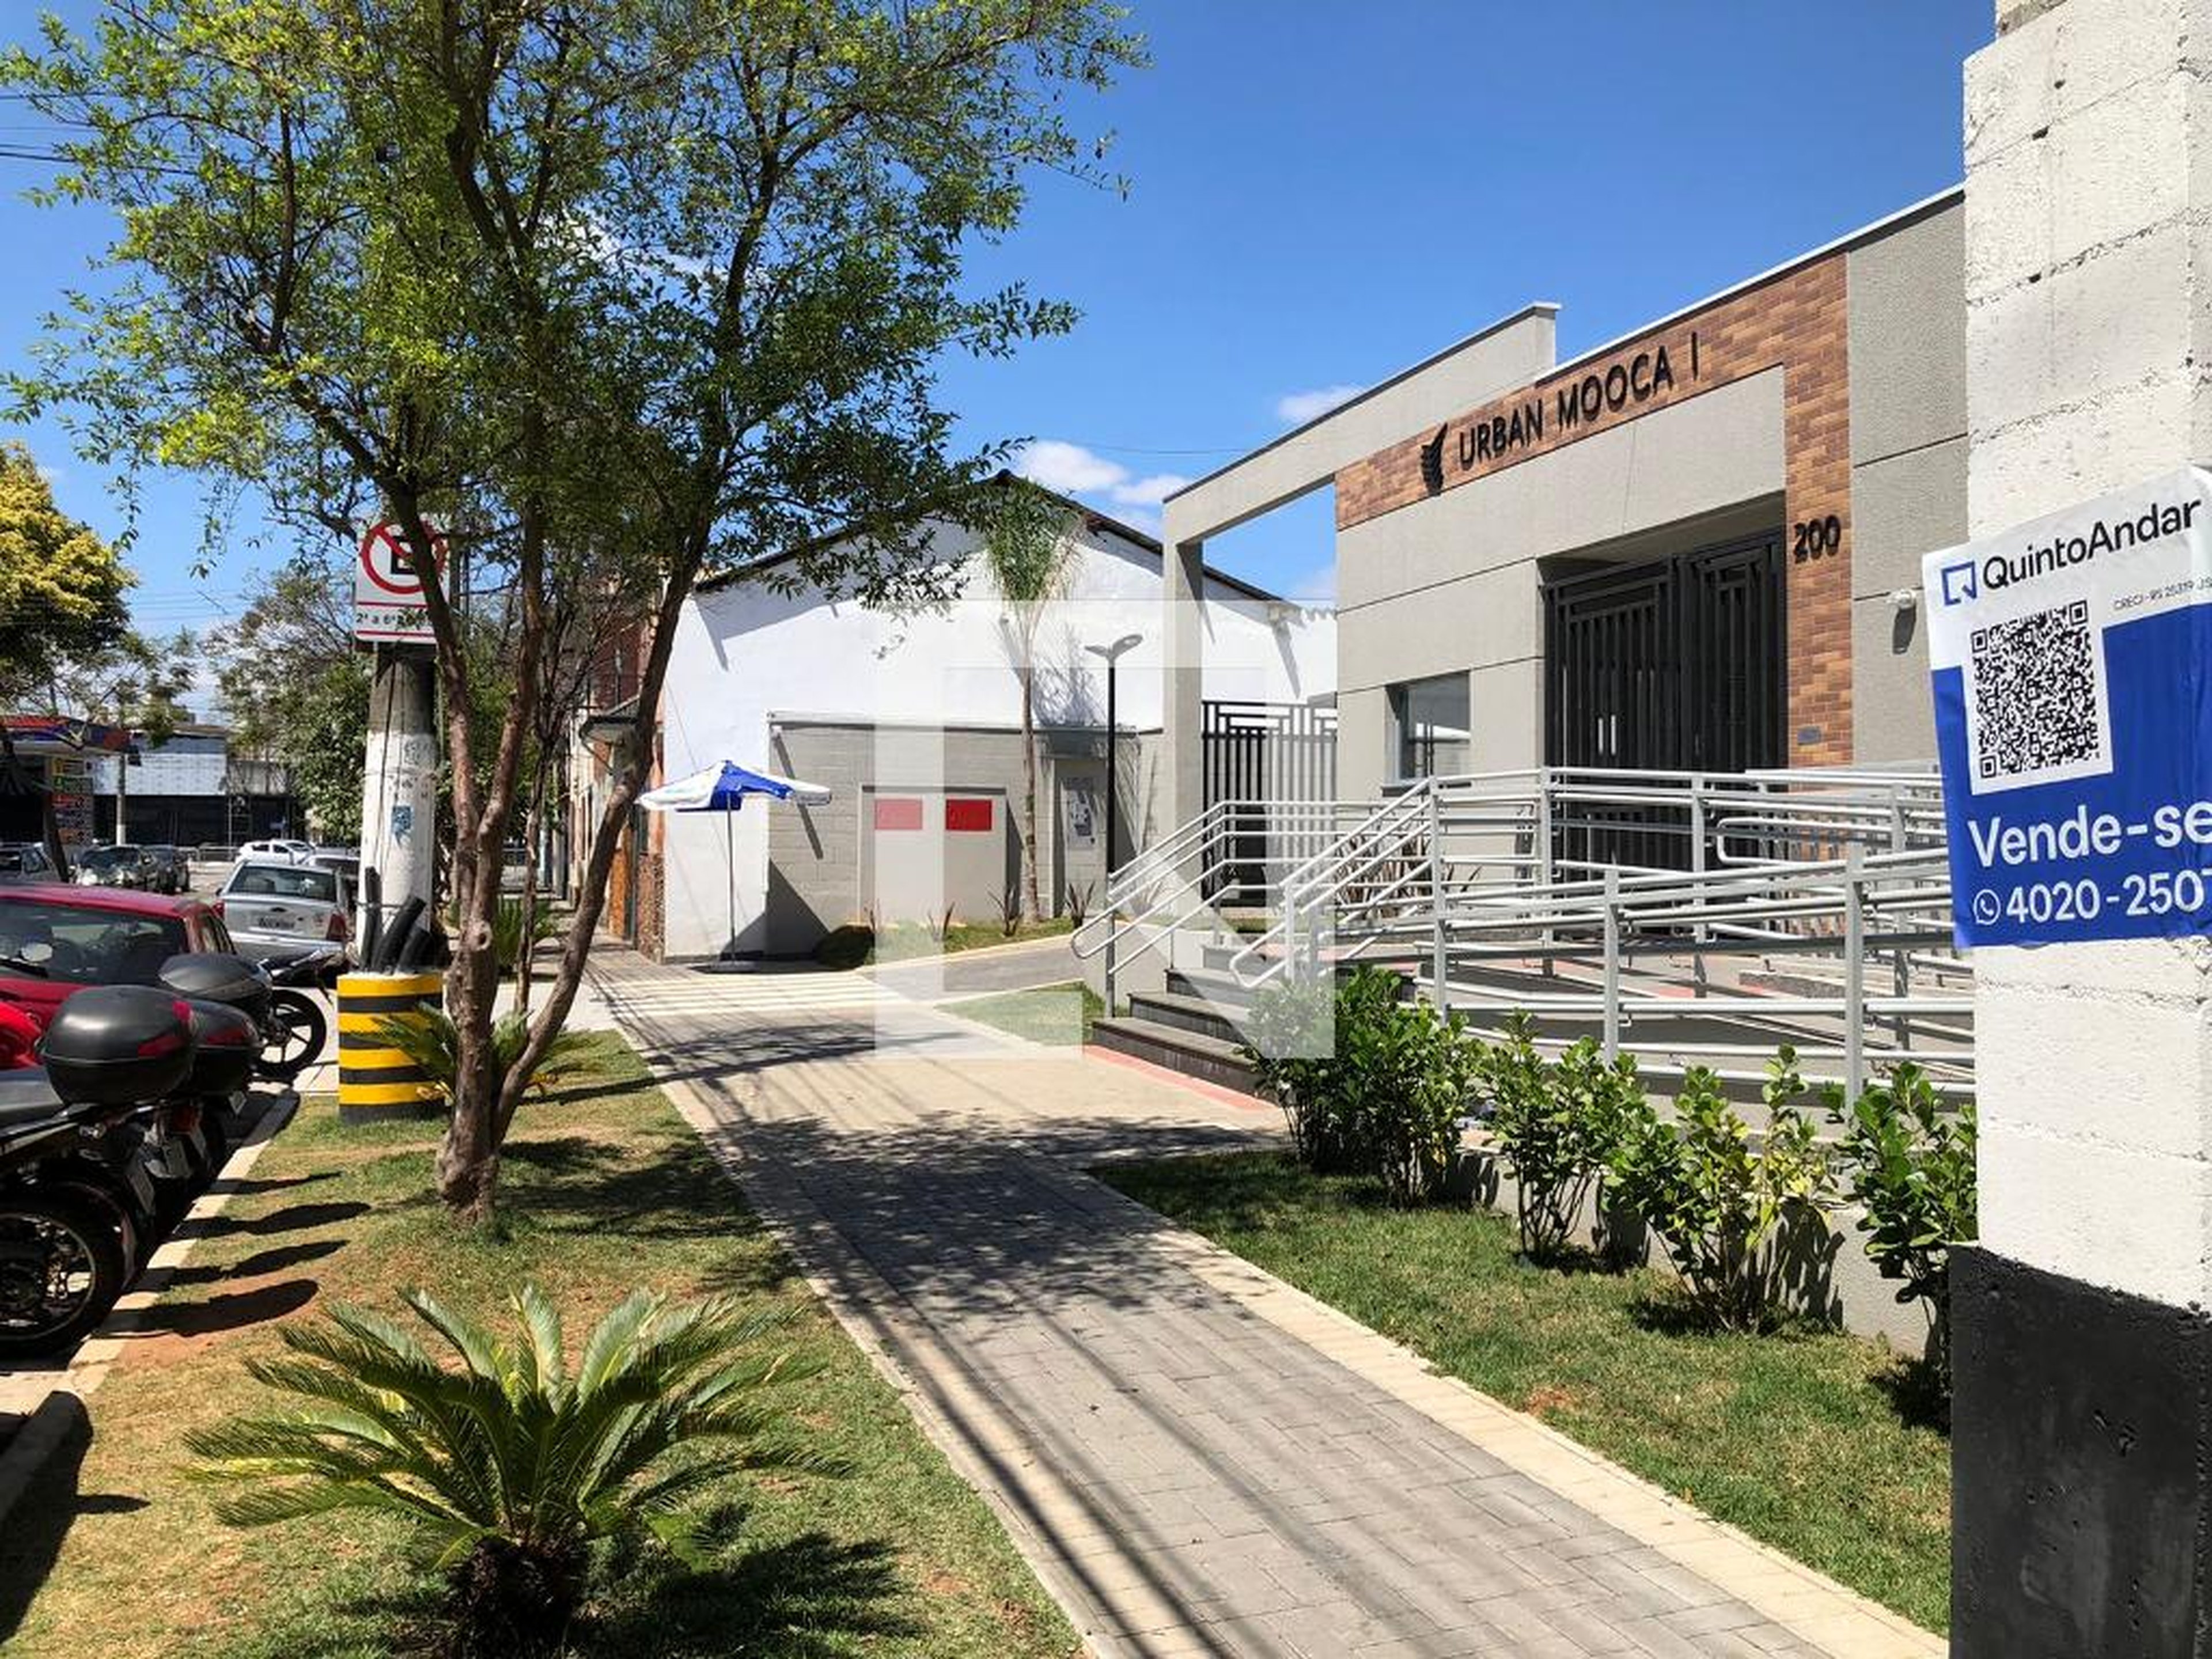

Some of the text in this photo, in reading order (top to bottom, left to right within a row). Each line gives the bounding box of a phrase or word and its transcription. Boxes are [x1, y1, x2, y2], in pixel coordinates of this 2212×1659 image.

[1459, 398, 1544, 471] URBAN
[1558, 345, 1674, 433] MOOCA
[1793, 514, 1841, 565] 200
[1983, 499, 2201, 589] QuintoAndar
[1967, 801, 2212, 868] Vende-se
